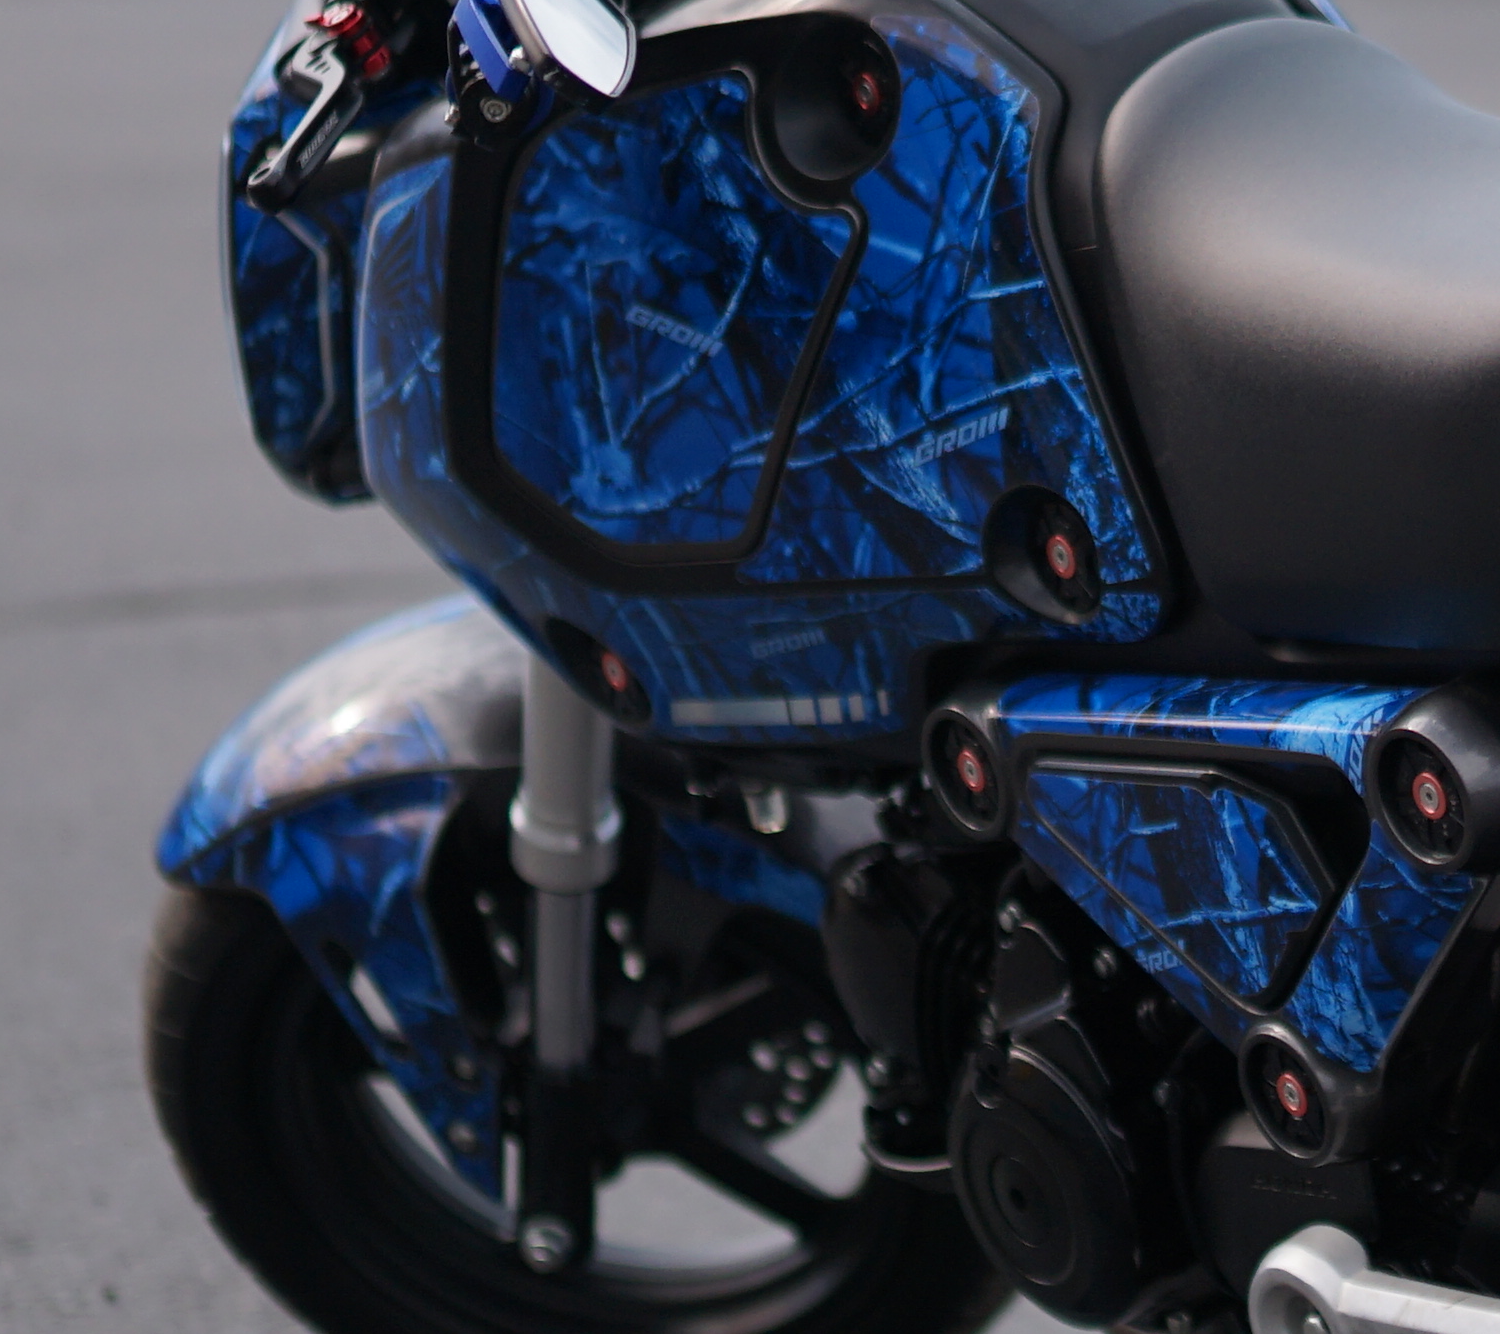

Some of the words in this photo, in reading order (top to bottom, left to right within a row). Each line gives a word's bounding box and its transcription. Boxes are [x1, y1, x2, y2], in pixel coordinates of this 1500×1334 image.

[625, 306, 723, 358] GROM
[913, 406, 1010, 468] GROM
[752, 625, 827, 660] GROM
